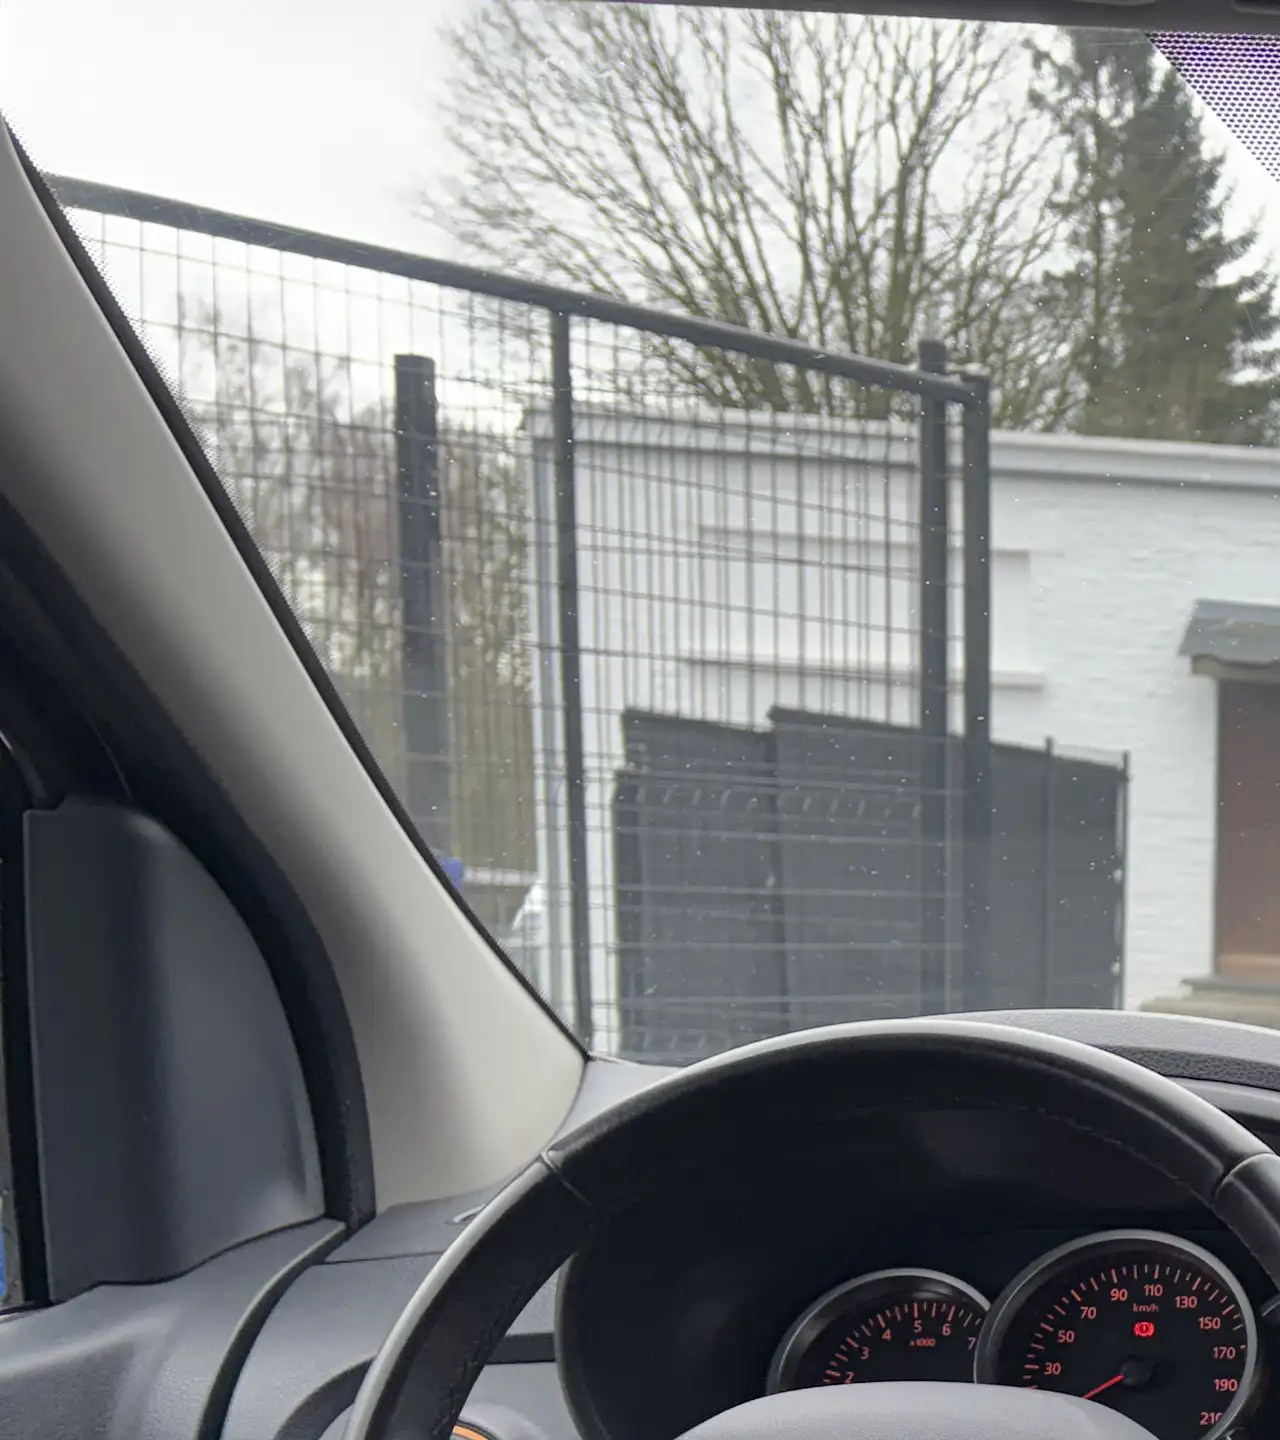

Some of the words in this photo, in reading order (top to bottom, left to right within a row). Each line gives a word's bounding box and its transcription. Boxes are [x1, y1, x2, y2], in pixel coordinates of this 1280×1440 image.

[1110, 1288, 1129, 1301] 90
[1143, 1284, 1164, 1297] 110
[1132, 1303, 1159, 1313] km/h
[1175, 1295, 1198, 1309] 130
[1080, 1306, 1097, 1320] 70
[913, 1320, 923, 1333] 5
[941, 1323, 952, 1337] 6
[1198, 1317, 1221, 1330] 150
[881, 1329, 893, 1341] 4
[1057, 1330, 1075, 1343] 50
[967, 1337, 977, 1350] 7
[860, 1346, 870, 1360] 3
[1212, 1346, 1236, 1359] 170
[1043, 1362, 1062, 1375] 30
[844, 1371, 854, 1384] 2
[1214, 1379, 1238, 1391] 190
